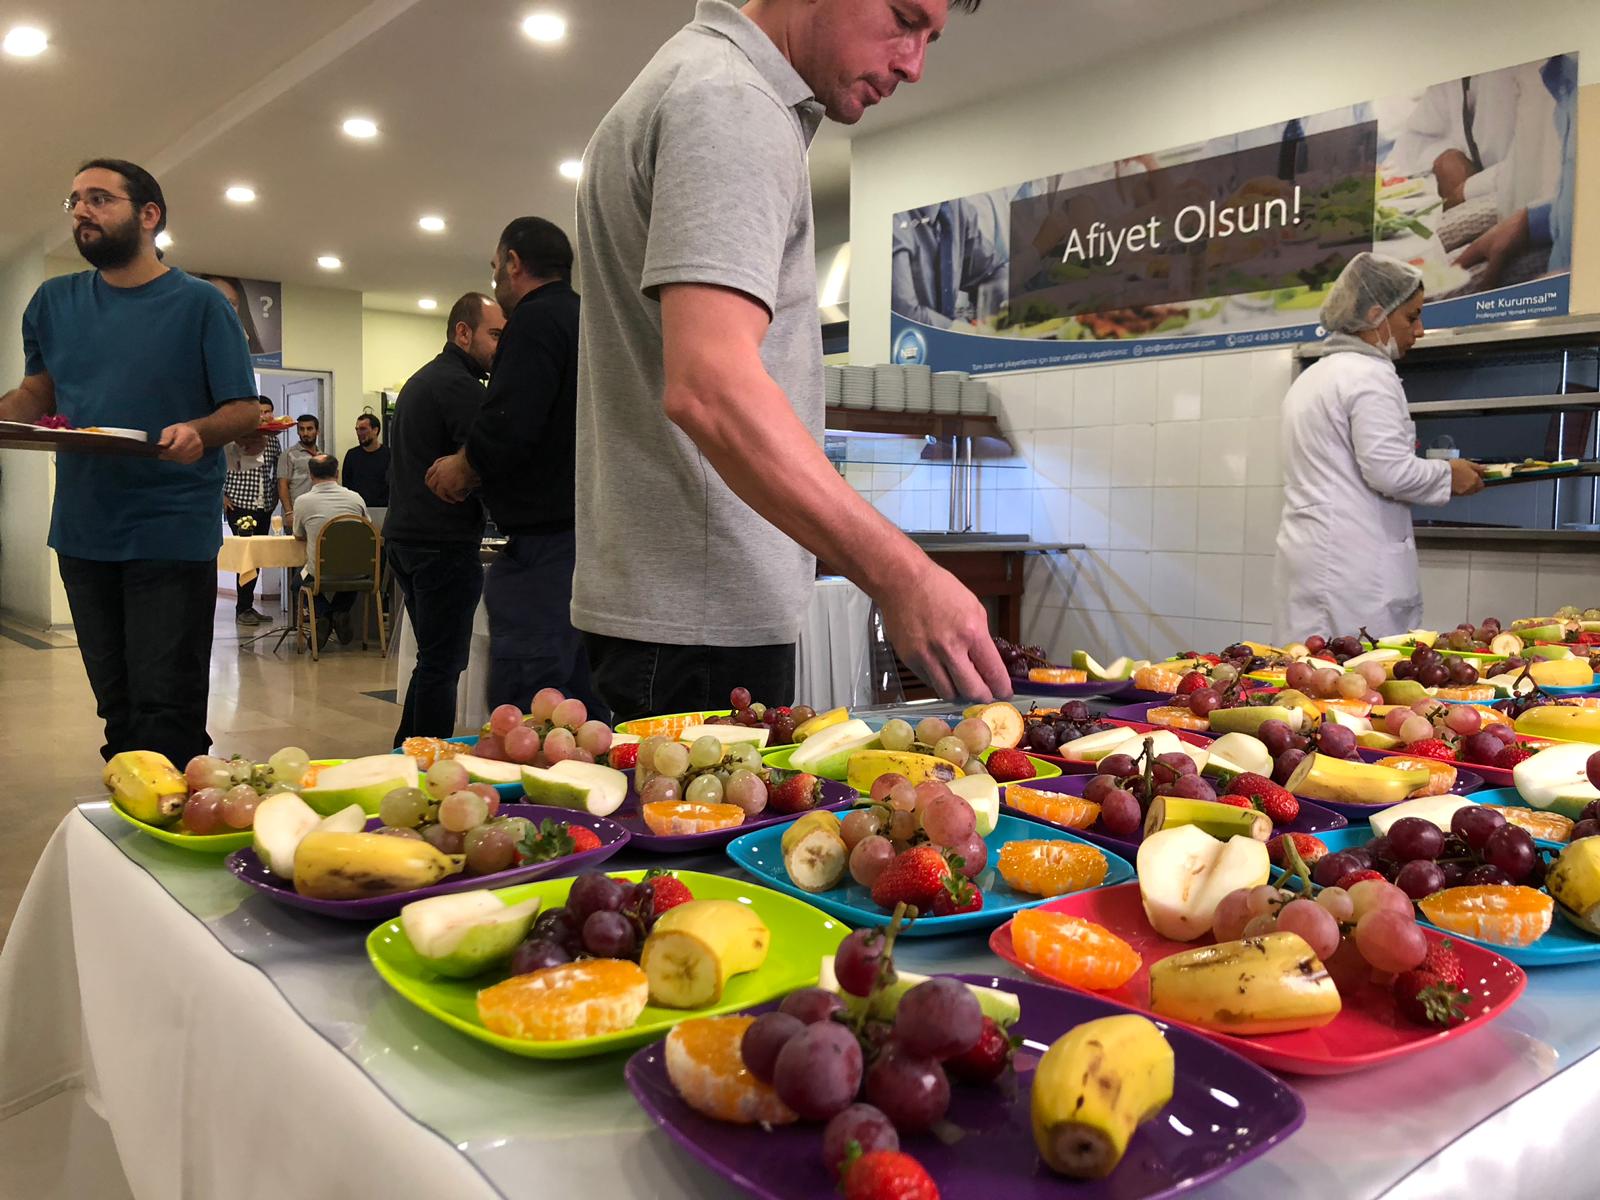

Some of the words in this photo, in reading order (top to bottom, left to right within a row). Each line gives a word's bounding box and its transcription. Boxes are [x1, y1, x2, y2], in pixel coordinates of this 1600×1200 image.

[1062, 216, 1161, 266] Afiyet
[1174, 185, 1301, 243] Olsun!
[260, 296, 274, 318] ?
[1476, 301, 1496, 310] Net
